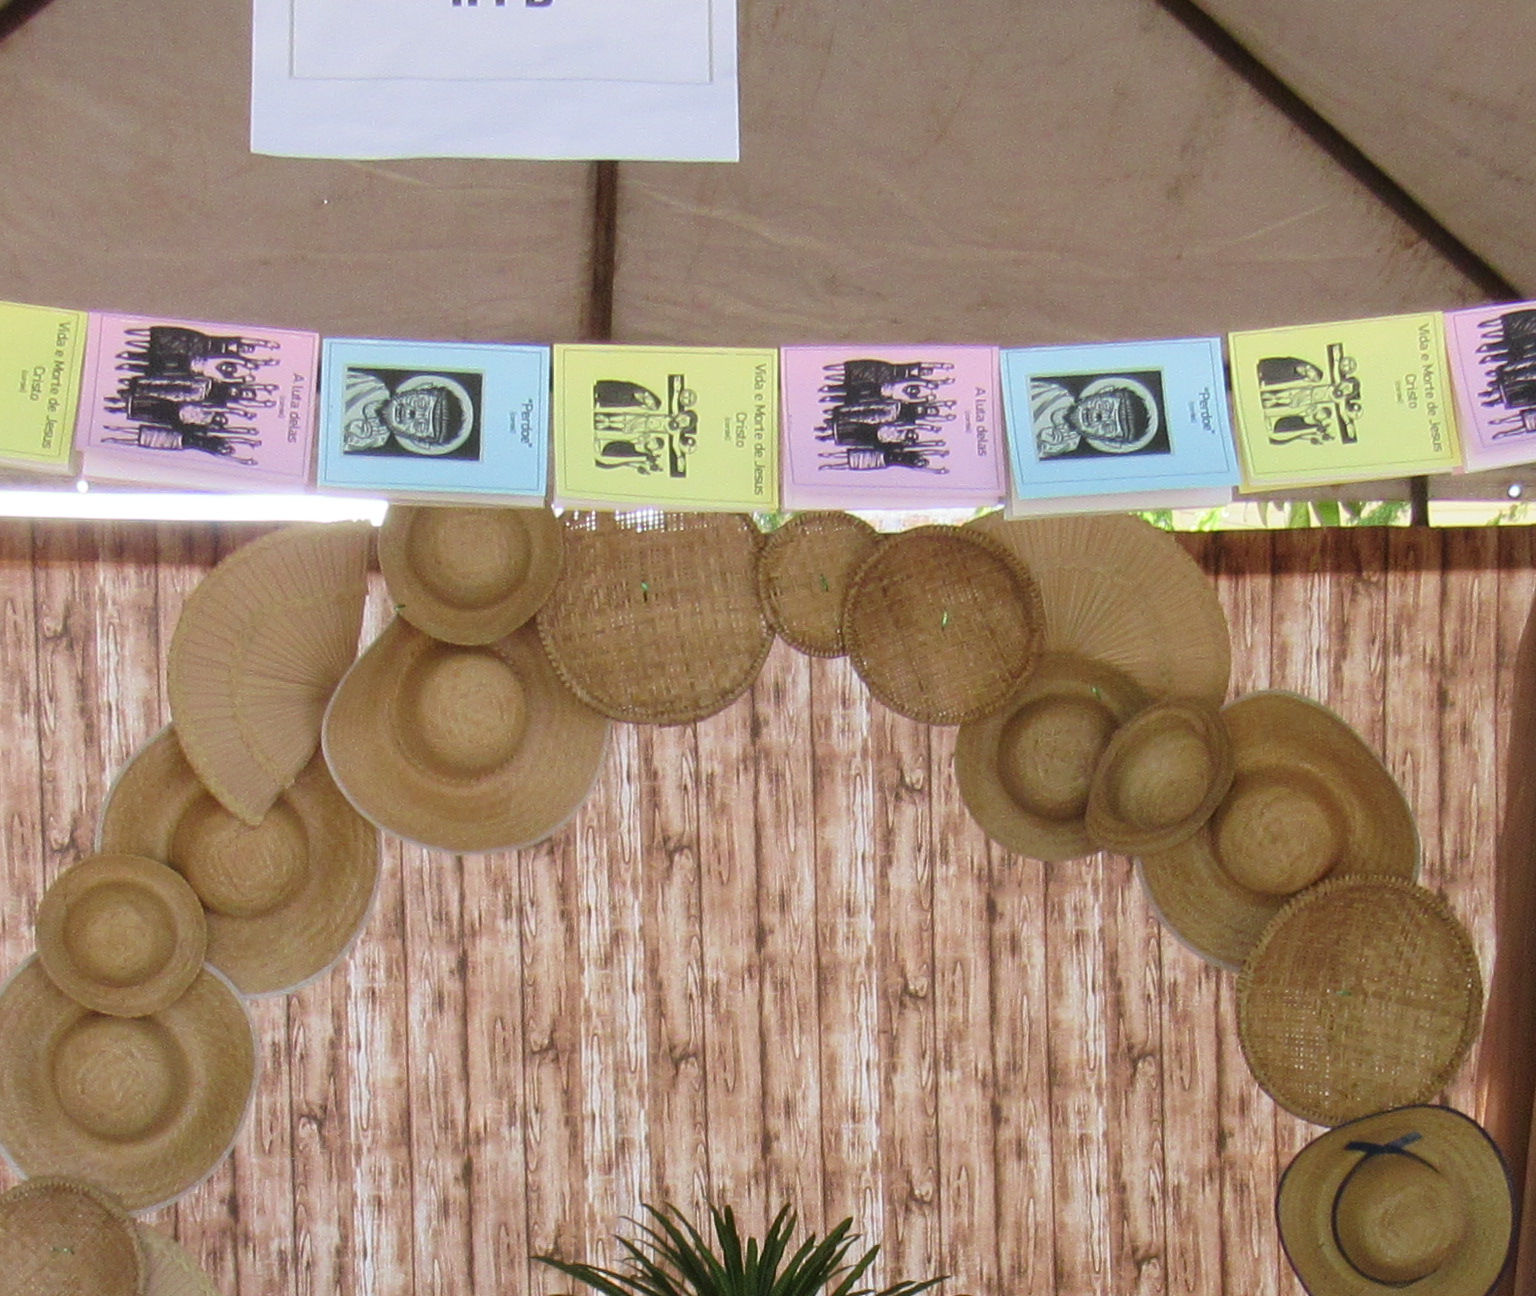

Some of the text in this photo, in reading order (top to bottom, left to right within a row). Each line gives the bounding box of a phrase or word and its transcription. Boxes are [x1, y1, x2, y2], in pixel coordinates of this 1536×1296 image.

[56, 322, 70, 346] Vida
[30, 366, 46, 401] Cristo
[51, 360, 66, 396] Morte
[755, 363, 767, 389] Vida
[1405, 374, 1417, 409] Cristo
[1418, 323, 1442, 453] Vida e Morte de Jesus
[48, 398, 60, 412] de
[288, 373, 304, 443] A luta delas
[755, 404, 766, 440] Morte
[975, 387, 988, 457] A luta delas
[42, 415, 57, 449] Jesus
[736, 412, 747, 448] Cristo
[755, 443, 765, 458] de
[755, 462, 765, 496] Jesus
